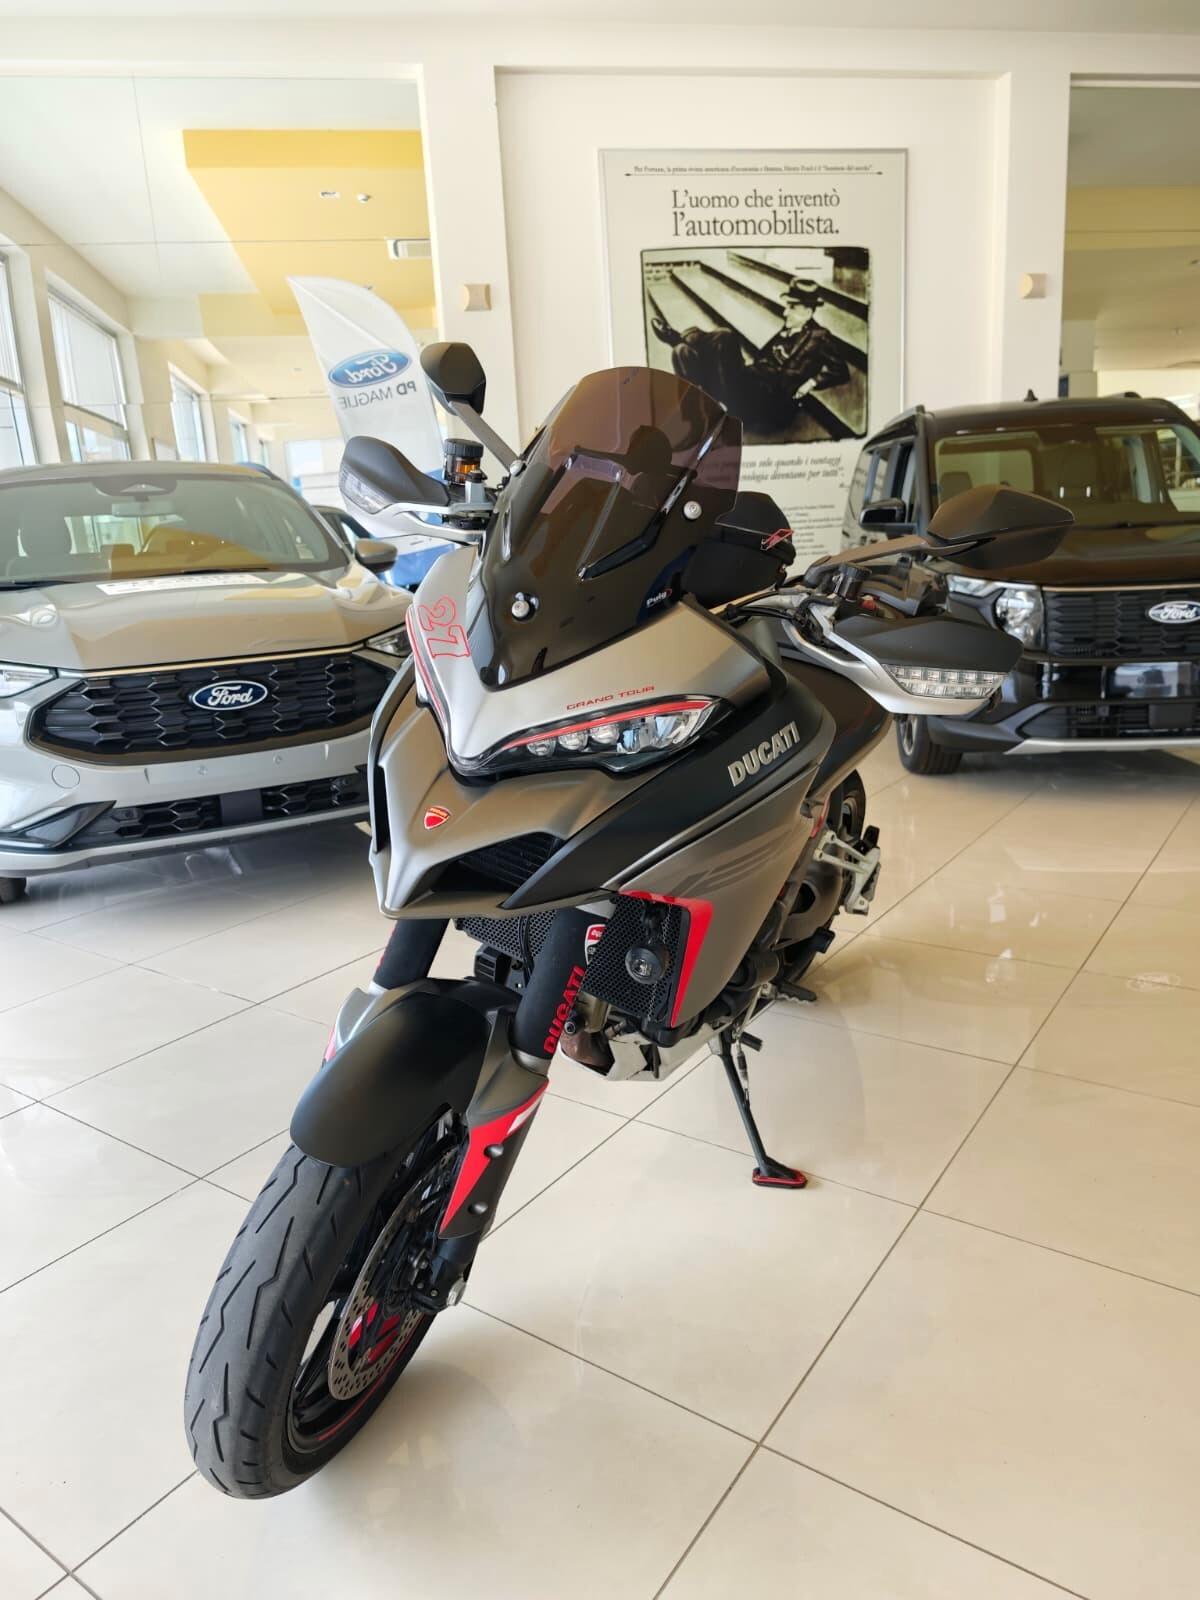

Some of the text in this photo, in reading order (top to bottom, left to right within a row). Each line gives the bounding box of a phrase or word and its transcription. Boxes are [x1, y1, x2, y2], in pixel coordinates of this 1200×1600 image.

[744, 188, 774, 208] che
[778, 188, 841, 208] inventò
[207, 684, 254, 707] Ford
[565, 685, 655, 711] GRAND TOUR
[727, 720, 801, 788] DUCATI
[543, 965, 586, 1054] DUCATI
